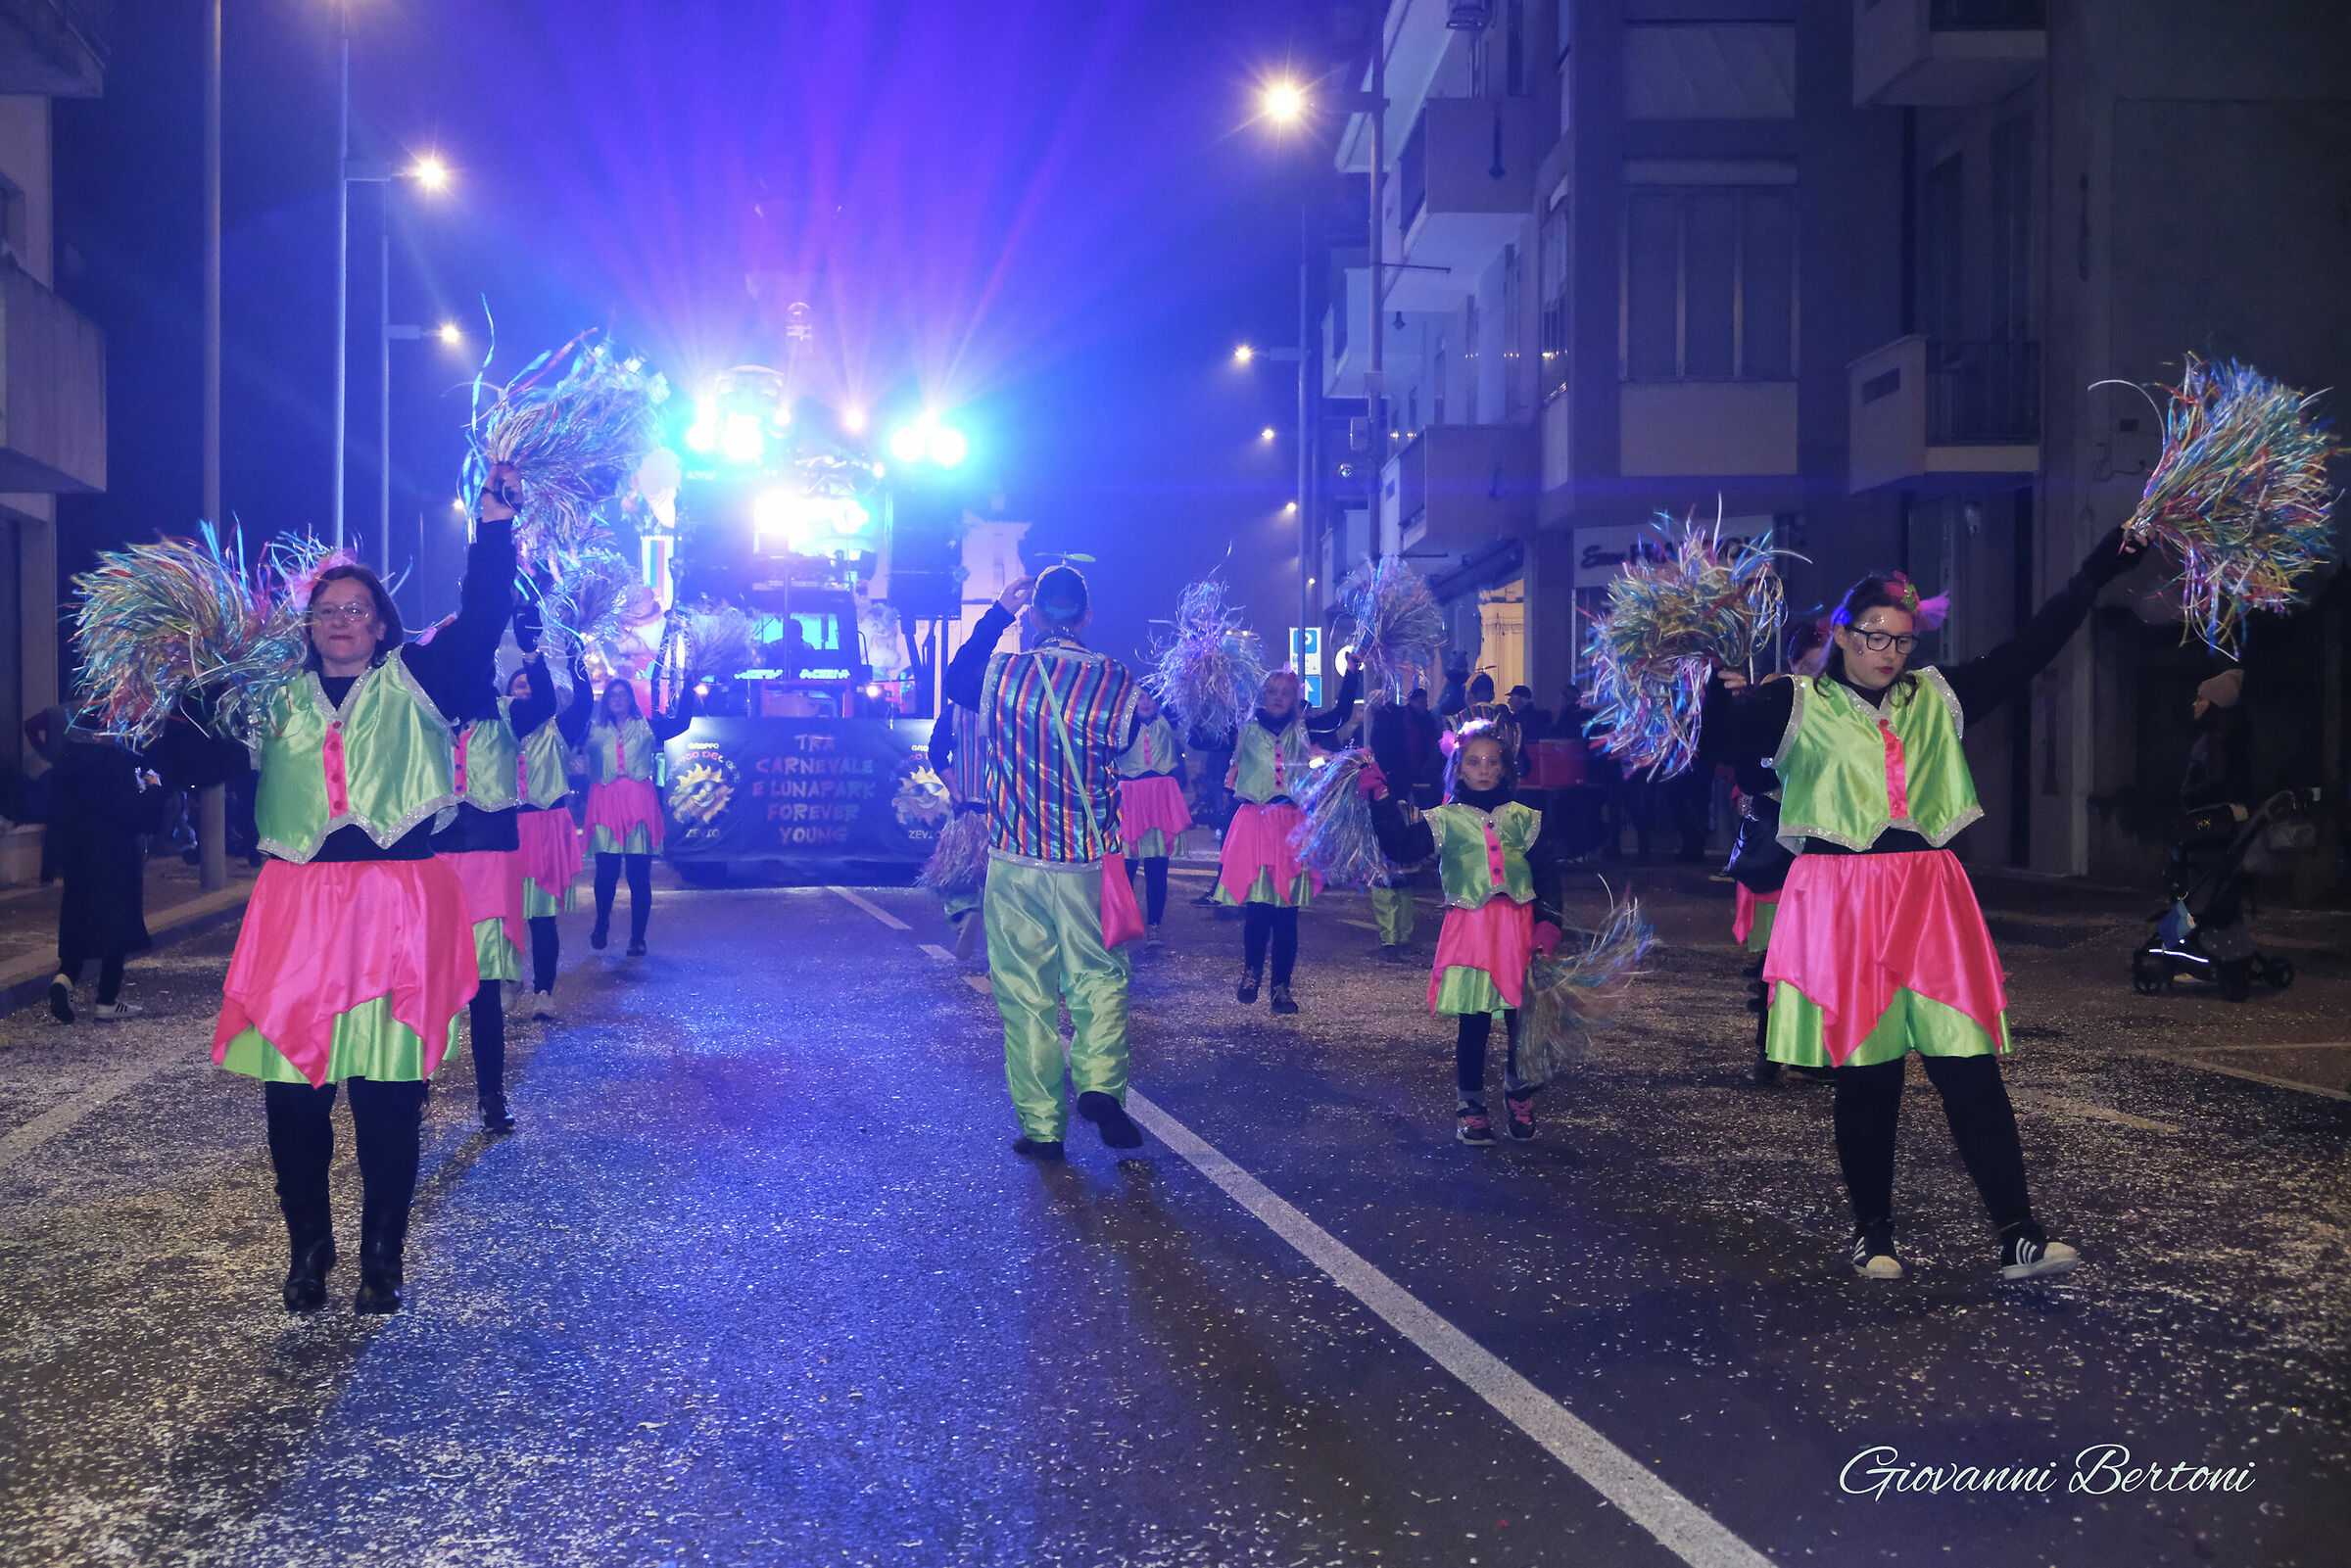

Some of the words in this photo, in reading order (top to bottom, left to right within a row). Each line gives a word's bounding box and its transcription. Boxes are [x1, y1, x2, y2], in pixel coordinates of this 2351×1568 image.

[794, 734, 836, 752] TRA
[702, 750, 724, 763] DEL
[755, 757, 875, 776] CARNEVALE
[752, 782, 764, 797] E
[771, 781, 877, 799] LUNAPARK
[767, 803, 861, 822] FOREVER
[779, 827, 848, 844] YOUNG
